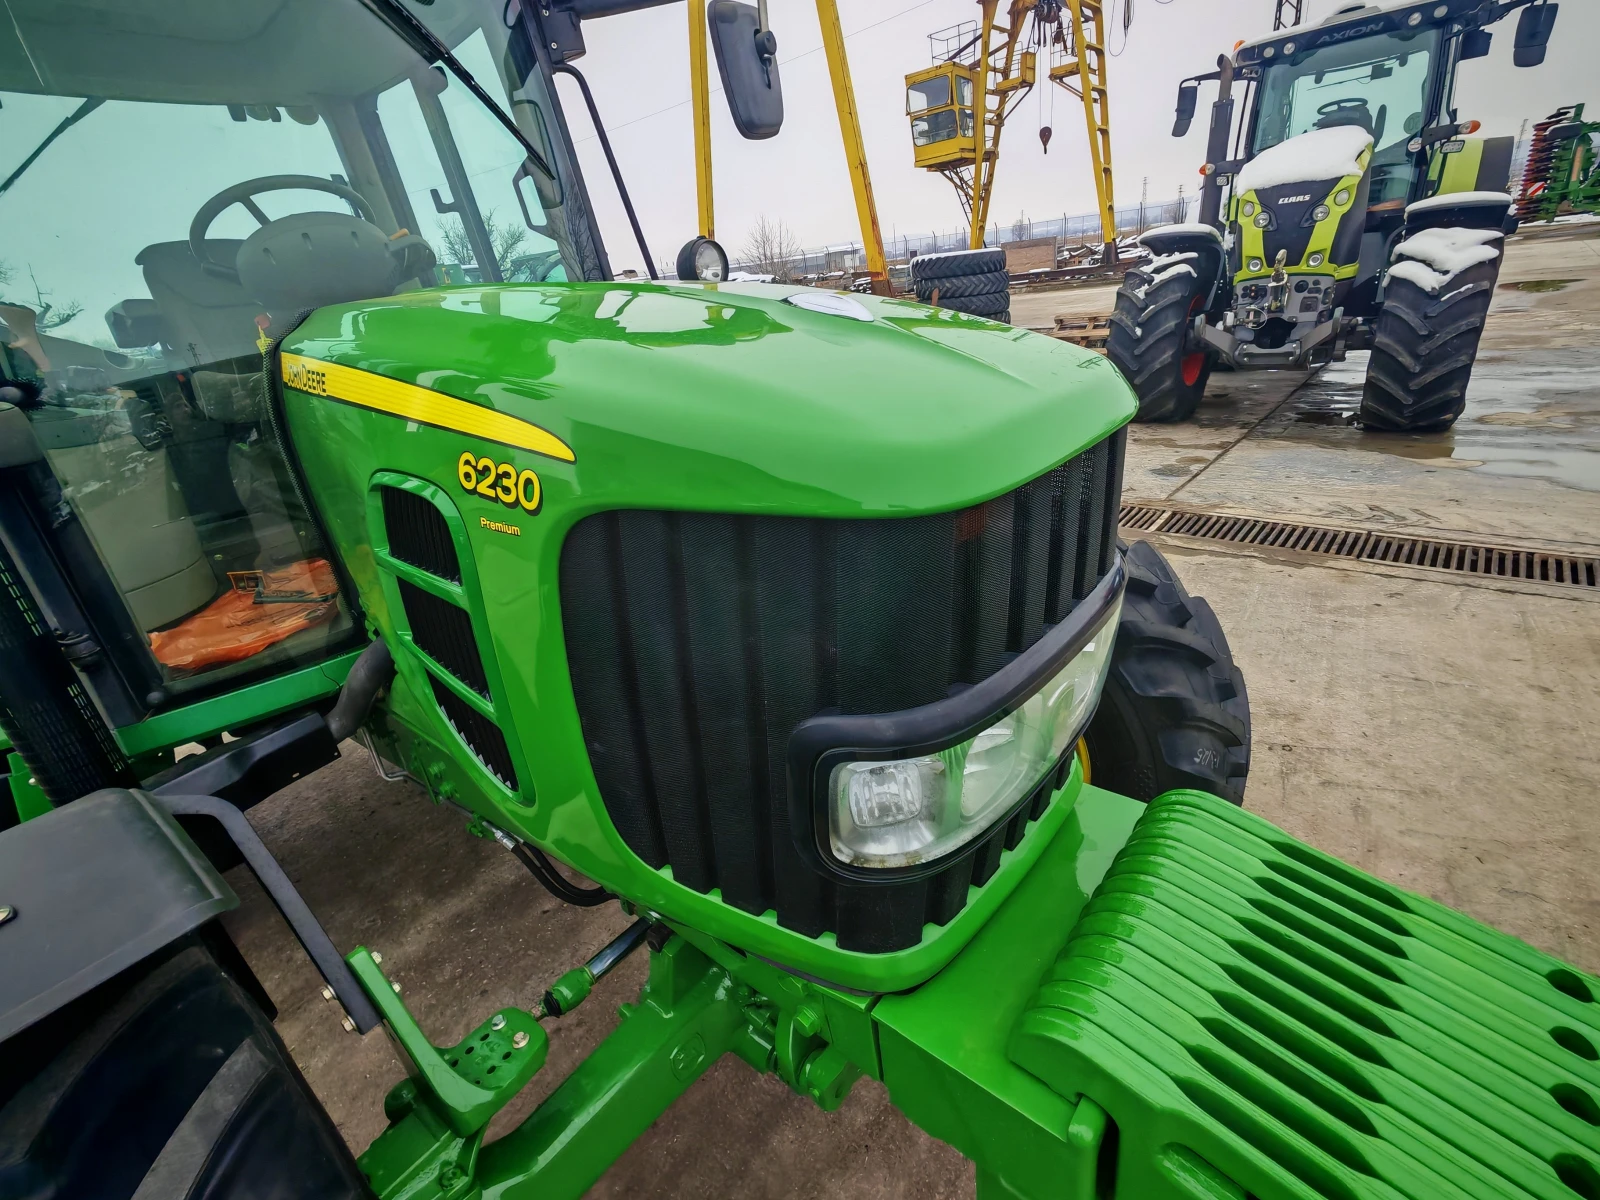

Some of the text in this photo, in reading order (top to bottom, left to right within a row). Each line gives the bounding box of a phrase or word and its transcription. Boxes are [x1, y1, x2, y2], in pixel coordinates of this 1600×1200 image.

[1316, 22, 1384, 44] AXION
[1278, 194, 1311, 205] CLAAS
[301, 363, 327, 393] DEERE
[458, 450, 543, 517] 6230
[480, 516, 521, 537] Premium
